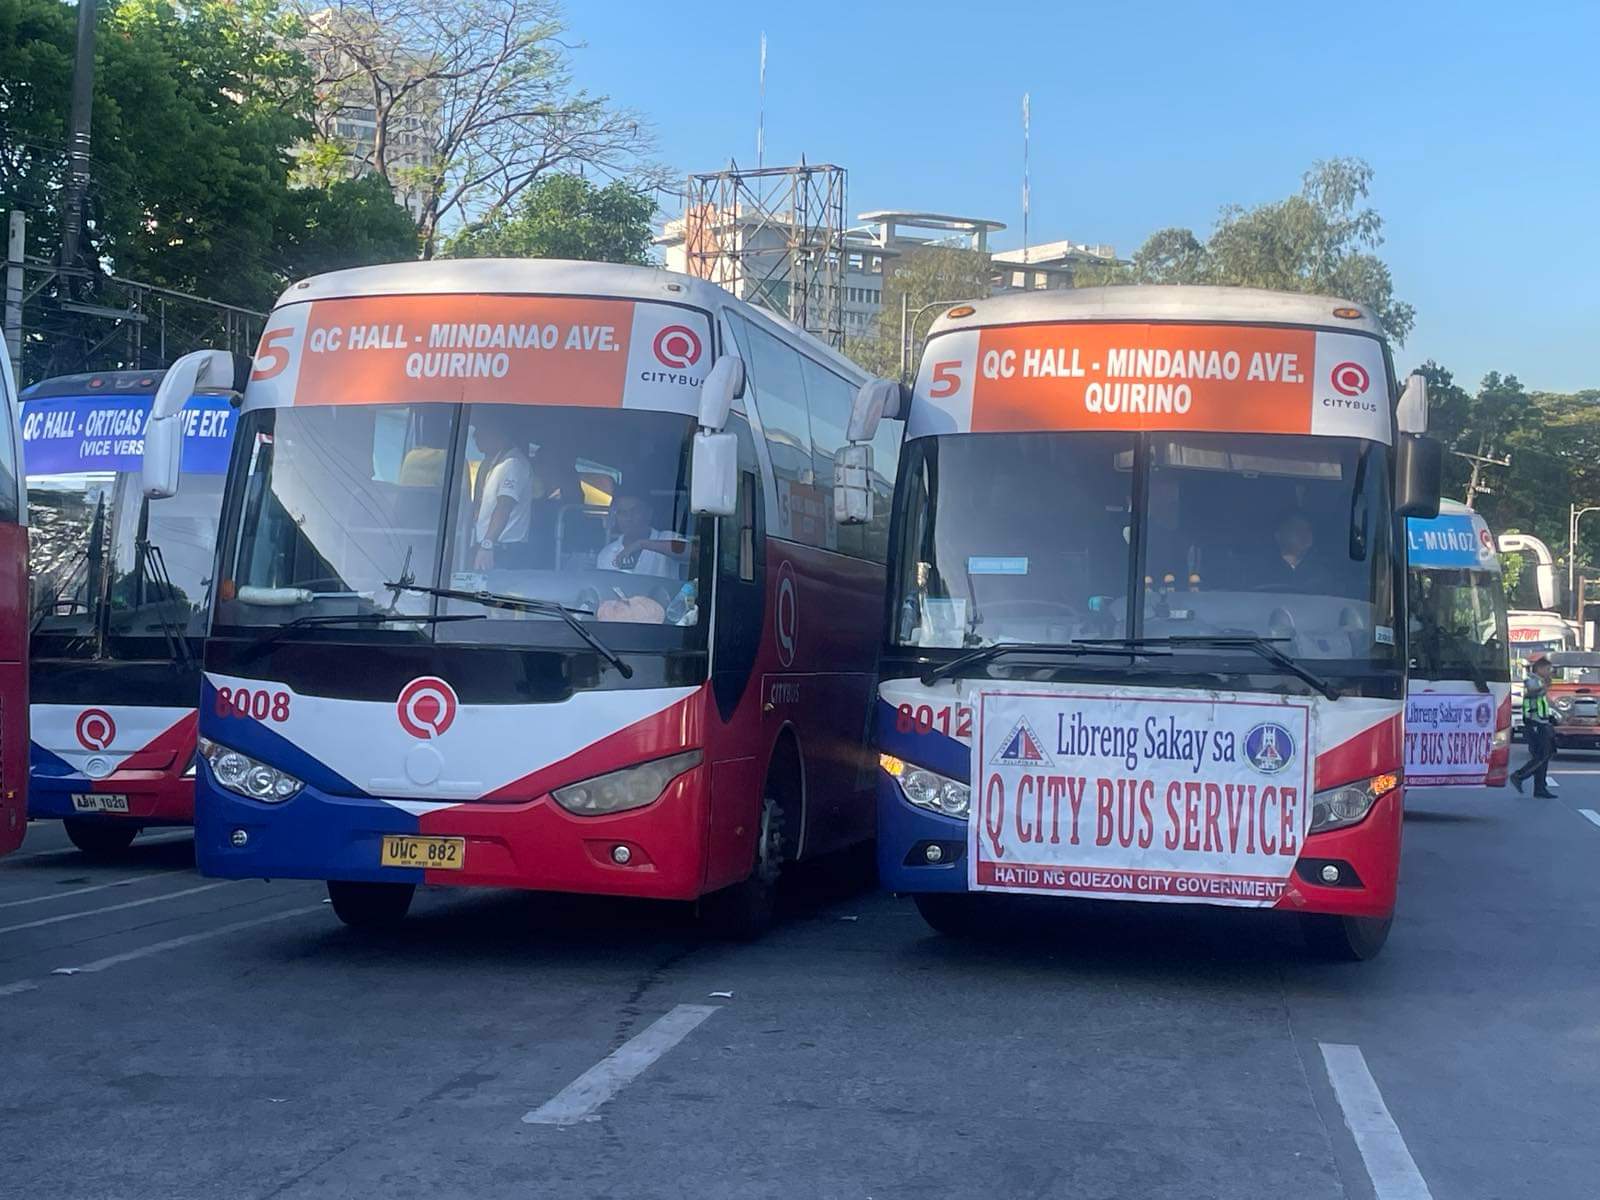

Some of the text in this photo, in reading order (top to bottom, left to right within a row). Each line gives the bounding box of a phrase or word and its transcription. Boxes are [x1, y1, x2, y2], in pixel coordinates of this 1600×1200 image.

[251, 327, 295, 381] 5
[310, 326, 342, 353] QC
[348, 325, 407, 349] HALL
[429, 324, 558, 349] MINDANAO
[565, 326, 620, 351] AVE.
[406, 352, 509, 379] QUIRINO
[930, 361, 962, 398] 5
[983, 350, 1016, 380] QC
[1023, 348, 1085, 377] HALL
[1107, 348, 1240, 380] MINDANAO
[1247, 352, 1304, 383] AVE.
[1085, 383, 1192, 414] QUIRINO
[1323, 398, 1376, 412] CITYBUS
[24, 412, 44, 441] QC
[43, 411, 76, 439] HALL
[85, 408, 144, 437] ORTIGAS
[199, 410, 230, 438] EXT.
[80, 440, 144, 459] (VICE VERS
[1407, 529, 1475, 552] L-MUÑOZ
[215, 687, 290, 722] 8008
[896, 703, 973, 737] 8012
[1057, 712, 1139, 771] Libreng
[1144, 716, 1208, 773] Sakay
[1213, 730, 1236, 762] sa
[1421, 732, 1444, 765] BUS
[985, 773, 1297, 858] Q CITY BUS SERVICE
[428, 844, 456, 861] 882
[994, 868, 1286, 897] HATID NG QUEZON CITY GOVERNMENT
